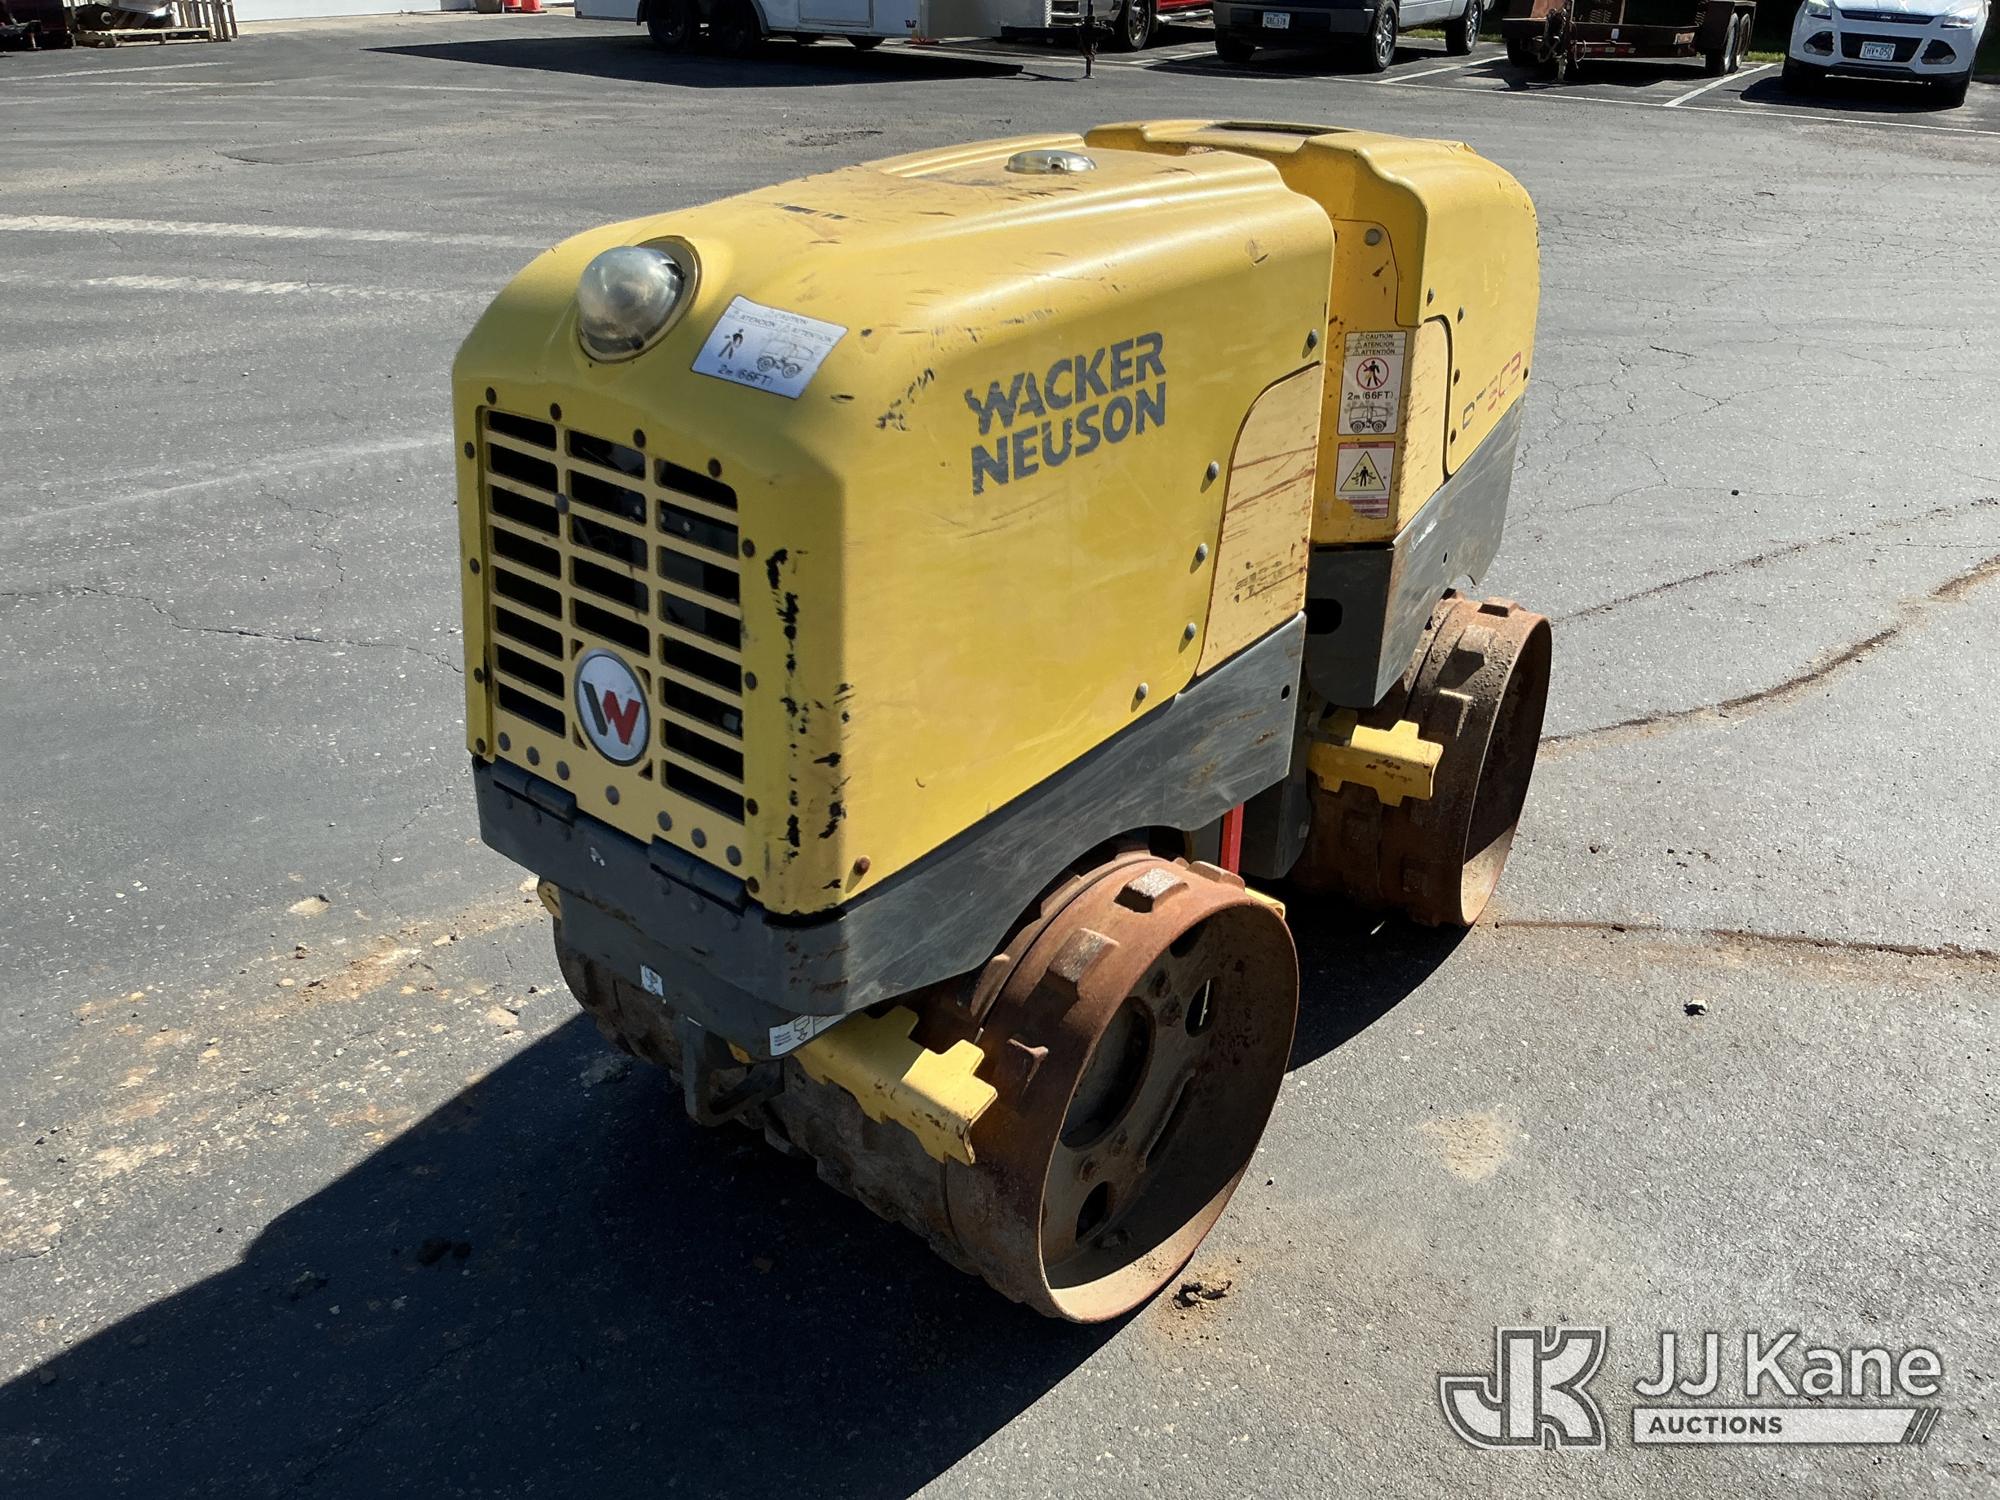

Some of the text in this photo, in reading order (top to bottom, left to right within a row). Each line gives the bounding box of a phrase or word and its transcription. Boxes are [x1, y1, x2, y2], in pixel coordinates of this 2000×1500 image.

[964, 331, 1167, 436] WACKER
[1347, 391, 1361, 401] 2m
[971, 380, 1166, 496] NEUSON
